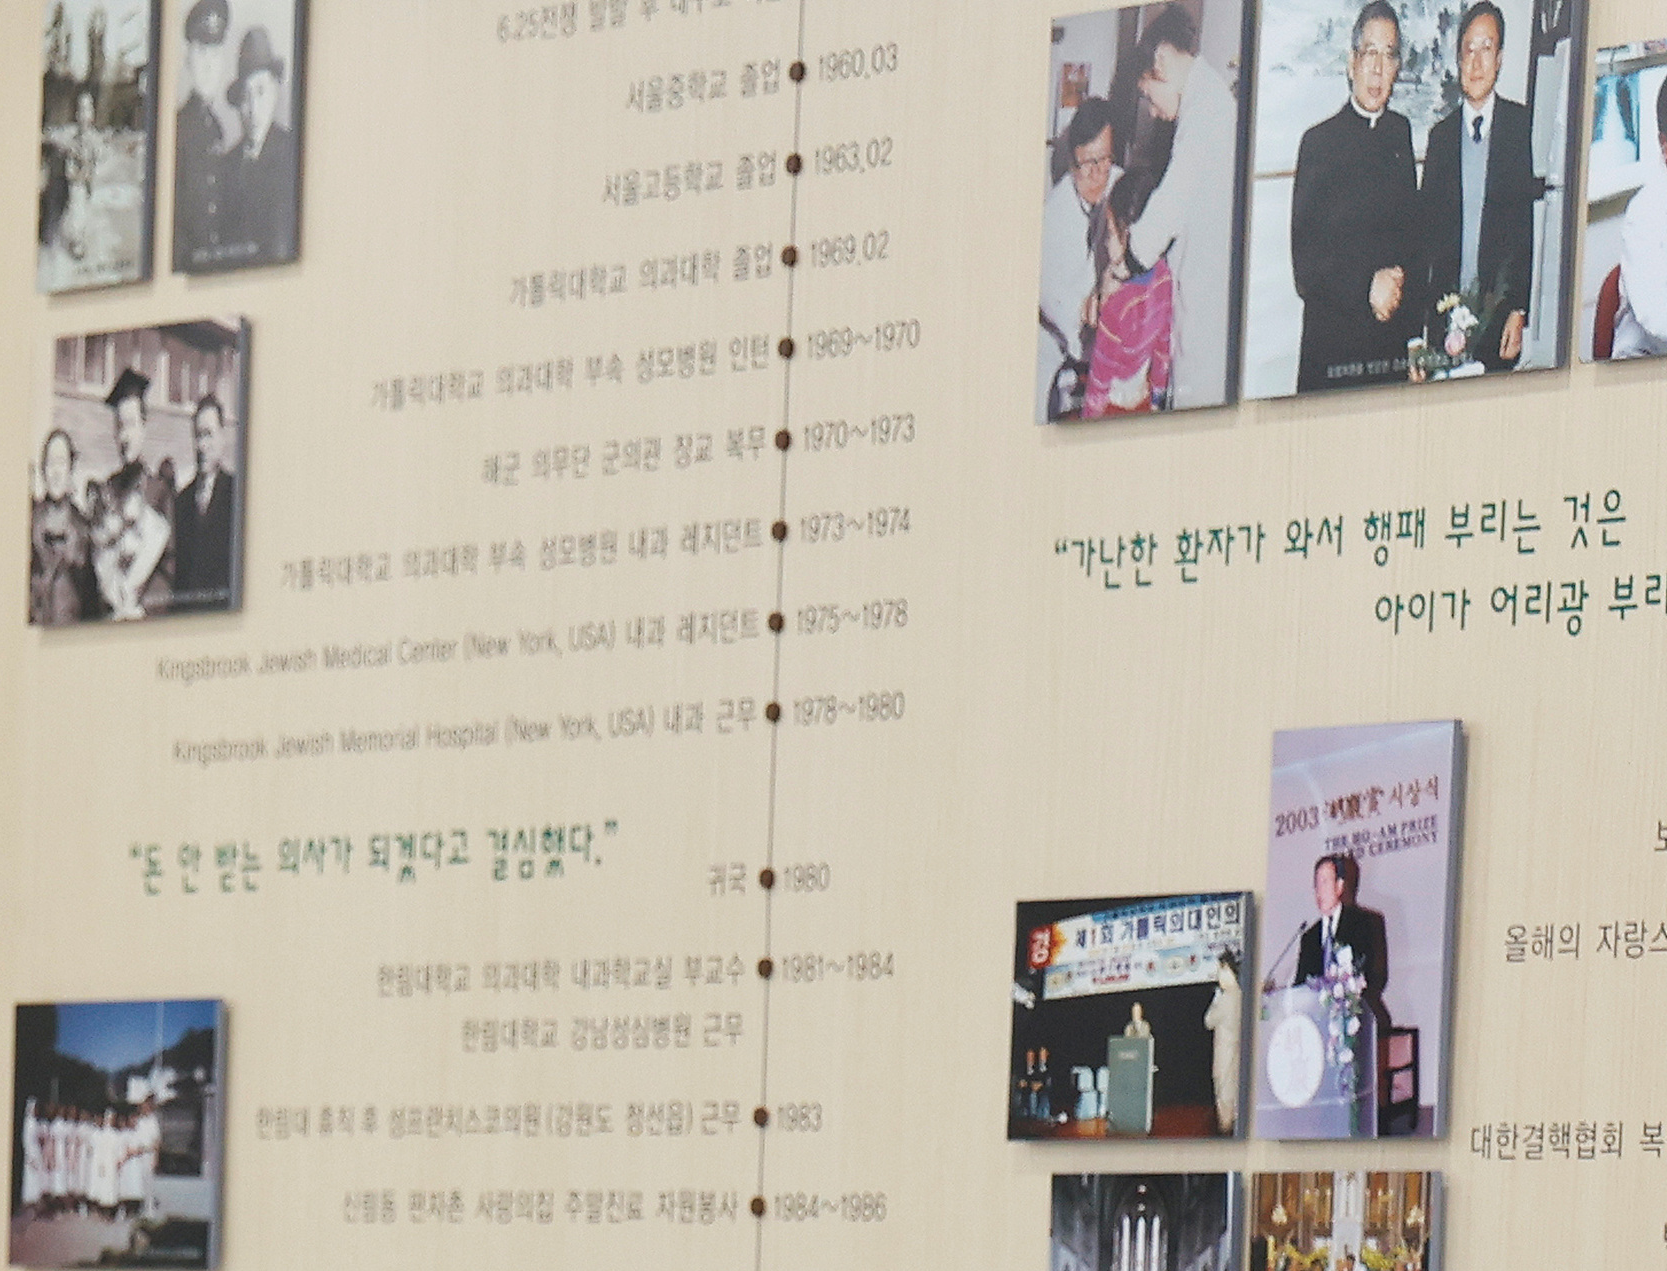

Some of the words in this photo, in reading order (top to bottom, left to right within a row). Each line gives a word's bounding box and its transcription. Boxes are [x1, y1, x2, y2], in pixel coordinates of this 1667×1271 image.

[626, 68, 727, 113] 서울중학교
[739, 58, 780, 98] 졸업
[818, 42, 899, 82] 1960.03
[602, 161, 724, 206] 서울고등학교
[736, 151, 776, 191] 졸업
[814, 136, 893, 175] 1963.02
[509, 264, 626, 308] 가톨릭대학교
[639, 251, 720, 292] 의과대학
[733, 243, 772, 281] 졸업
[811, 230, 890, 269] 1969.02
[371, 370, 484, 411] 가톨릭대학교
[496, 358, 573, 396] 의과대학
[584, 354, 624, 386] 부속
[636, 341, 717, 385] 성모병원
[729, 334, 769, 371] 인턴
[482, 451, 521, 486] 해군
[532, 445, 590, 481] 의무단
[602, 438, 662, 477] 군의관
[675, 433, 713, 470] 장교
[726, 426, 766, 462] 복무
[402, 544, 479, 579] 의과대학
[539, 529, 617, 571] 성모병원
[628, 526, 667, 560] 내과
[680, 516, 763, 555] 레지던트
[1174, 522, 1266, 583] 환자가
[1284, 514, 1344, 559] 와서
[1364, 508, 1426, 567] 행패
[1444, 499, 1542, 554] 부리는
[1563, 489, 1627, 549] 것은
[1375, 587, 1471, 636] 아이가
[1491, 579, 1590, 637] 어리광
[257, 648, 317, 676] Jewish
[321, 642, 392, 669] Medical
[397, 636, 458, 666] Center
[568, 619, 617, 653] USA)
[626, 615, 665, 649] 내과
[677, 608, 759, 645] 레지던트
[273, 731, 334, 760] Jewish
[339, 723, 419, 754] Memorial
[426, 720, 498, 752] Hospital
[608, 704, 655, 740] USA)
[663, 702, 704, 737] 내과
[716, 696, 756, 735] 근무
[1275, 805, 1320, 837] 2003
[178, 842, 201, 894] 안
[215, 839, 262, 893] 받는
[278, 833, 353, 876] 의사가
[368, 827, 469, 885] 되겠다고
[709, 861, 747, 898] 귀국
[783, 862, 830, 893] 1980
[1505, 922, 1580, 962] 올해의
[377, 962, 471, 998] 한림대학교
[482, 959, 561, 993] 의과대학
[571, 955, 672, 991] 내과학교실
[683, 952, 746, 986] 부교수
[462, 1016, 558, 1054] 한림대학교
[703, 1012, 744, 1049] 근무
[700, 1100, 741, 1136] 근무
[777, 1102, 822, 1133] 1983
[1471, 1121, 1623, 1161] 대한결핵협회
